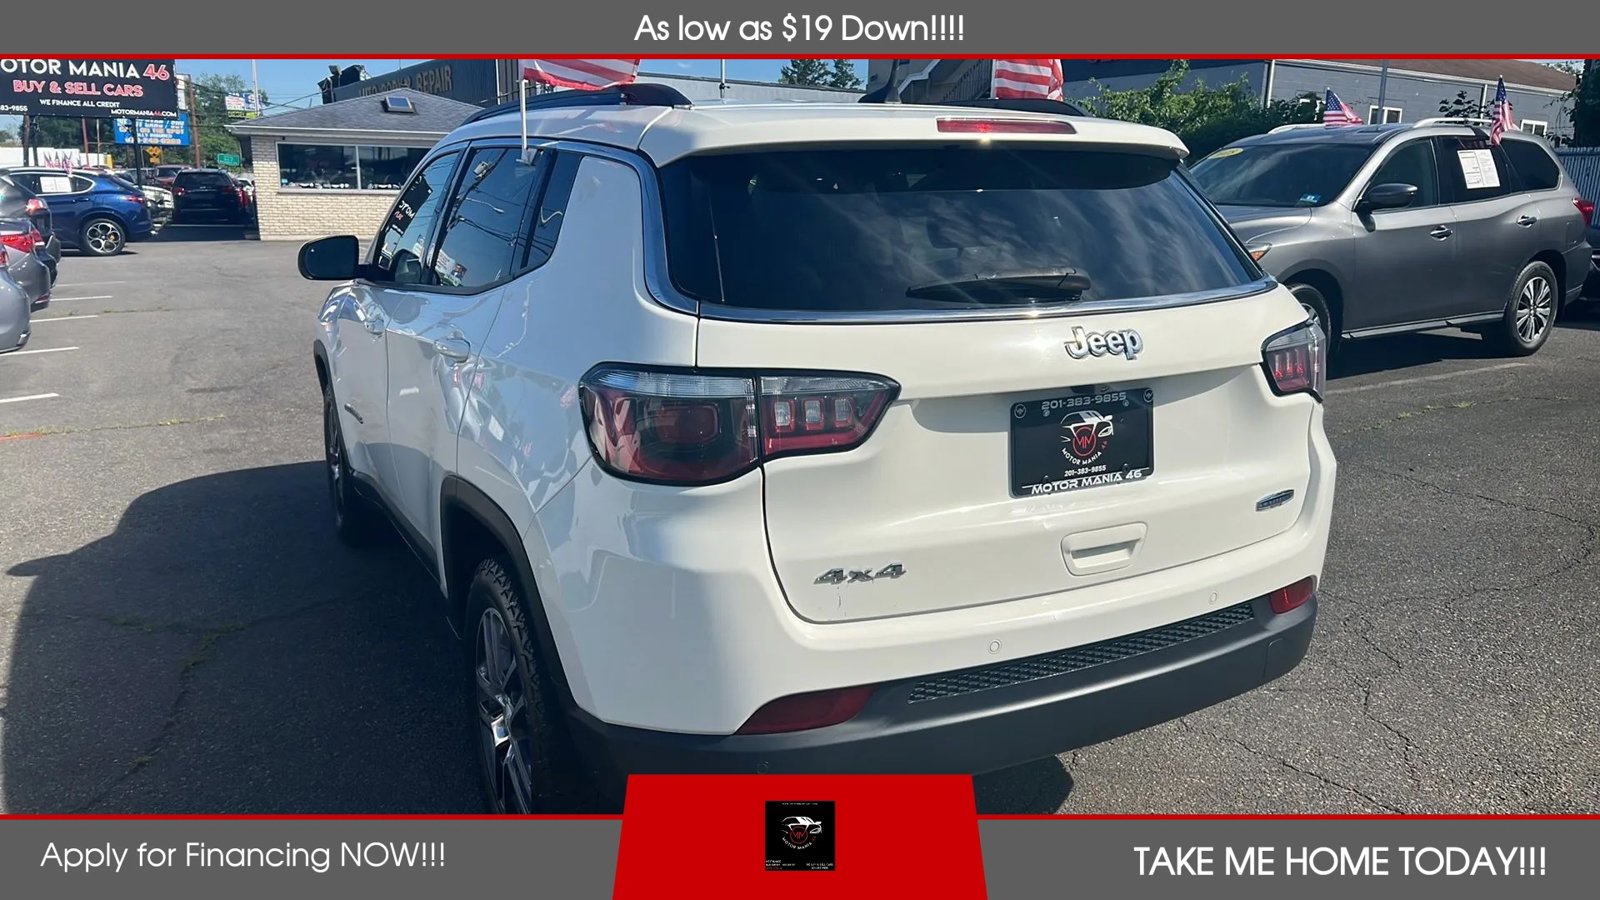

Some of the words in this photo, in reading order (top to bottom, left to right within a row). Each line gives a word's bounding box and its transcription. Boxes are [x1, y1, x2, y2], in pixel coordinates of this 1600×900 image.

[0, 59, 61, 75] OTOR
[68, 60, 140, 78] MANIA
[143, 63, 170, 81] 46
[416, 65, 453, 93] REPAIR
[13, 79, 46, 93] BUY
[49, 80, 62, 94] &
[64, 81, 101, 96] SELL
[103, 83, 144, 98] CARS
[0, 104, 28, 112] 83-9855
[52, 99, 81, 107] FINANCE
[96, 101, 120, 109] CREDIT
[1064, 326, 1143, 360] Jeep
[1061, 448, 1081, 465] MOTOR
[1082, 451, 1103, 465] MANIA
[1031, 478, 1079, 495] MOTOR
[1081, 472, 1123, 487] MANIA
[1125, 470, 1143, 479] 46
[813, 563, 907, 585] 4x4
